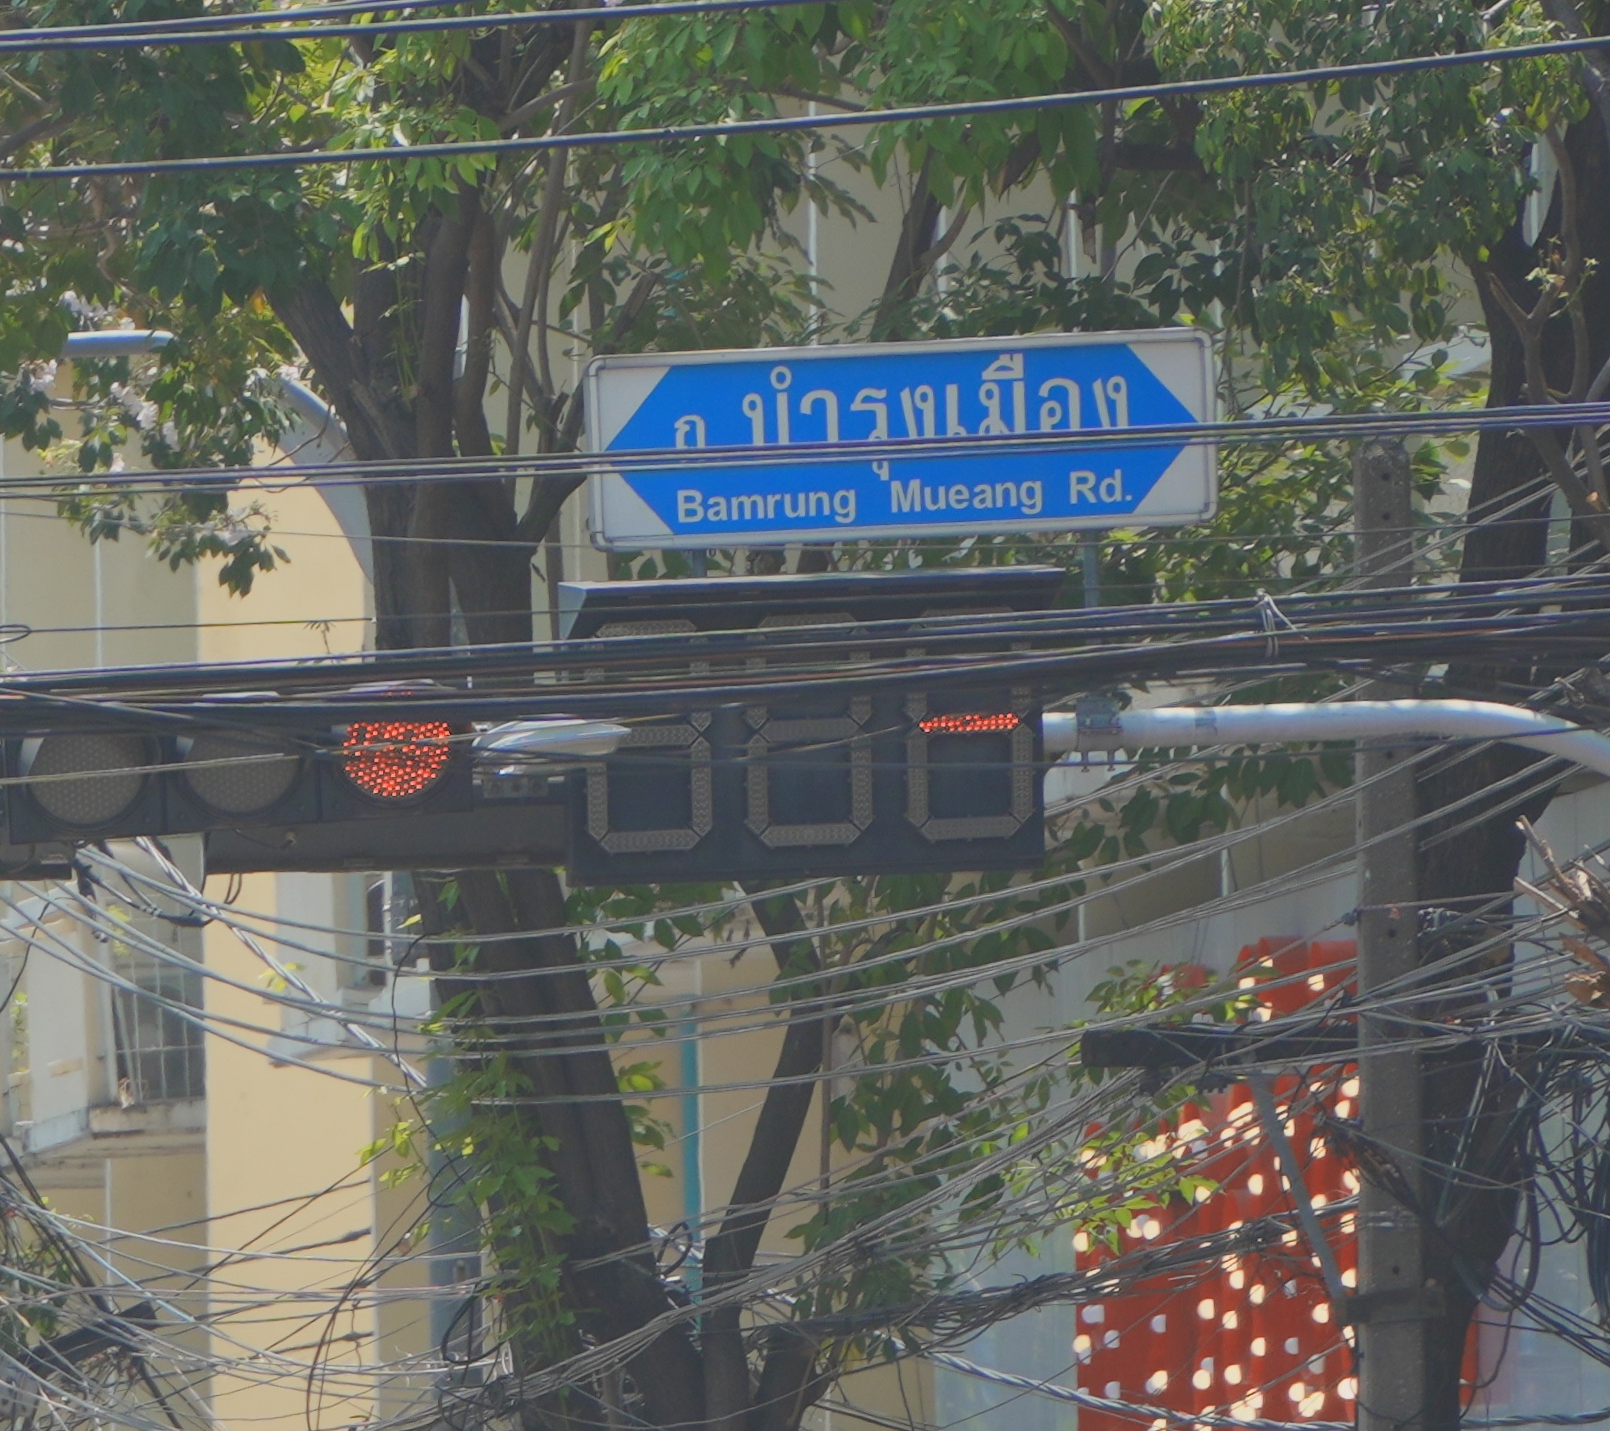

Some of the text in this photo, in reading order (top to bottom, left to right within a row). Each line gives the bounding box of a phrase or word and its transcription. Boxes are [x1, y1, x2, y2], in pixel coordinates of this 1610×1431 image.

[677, 469, 1133, 525] Bamrung Mueang Rd.
